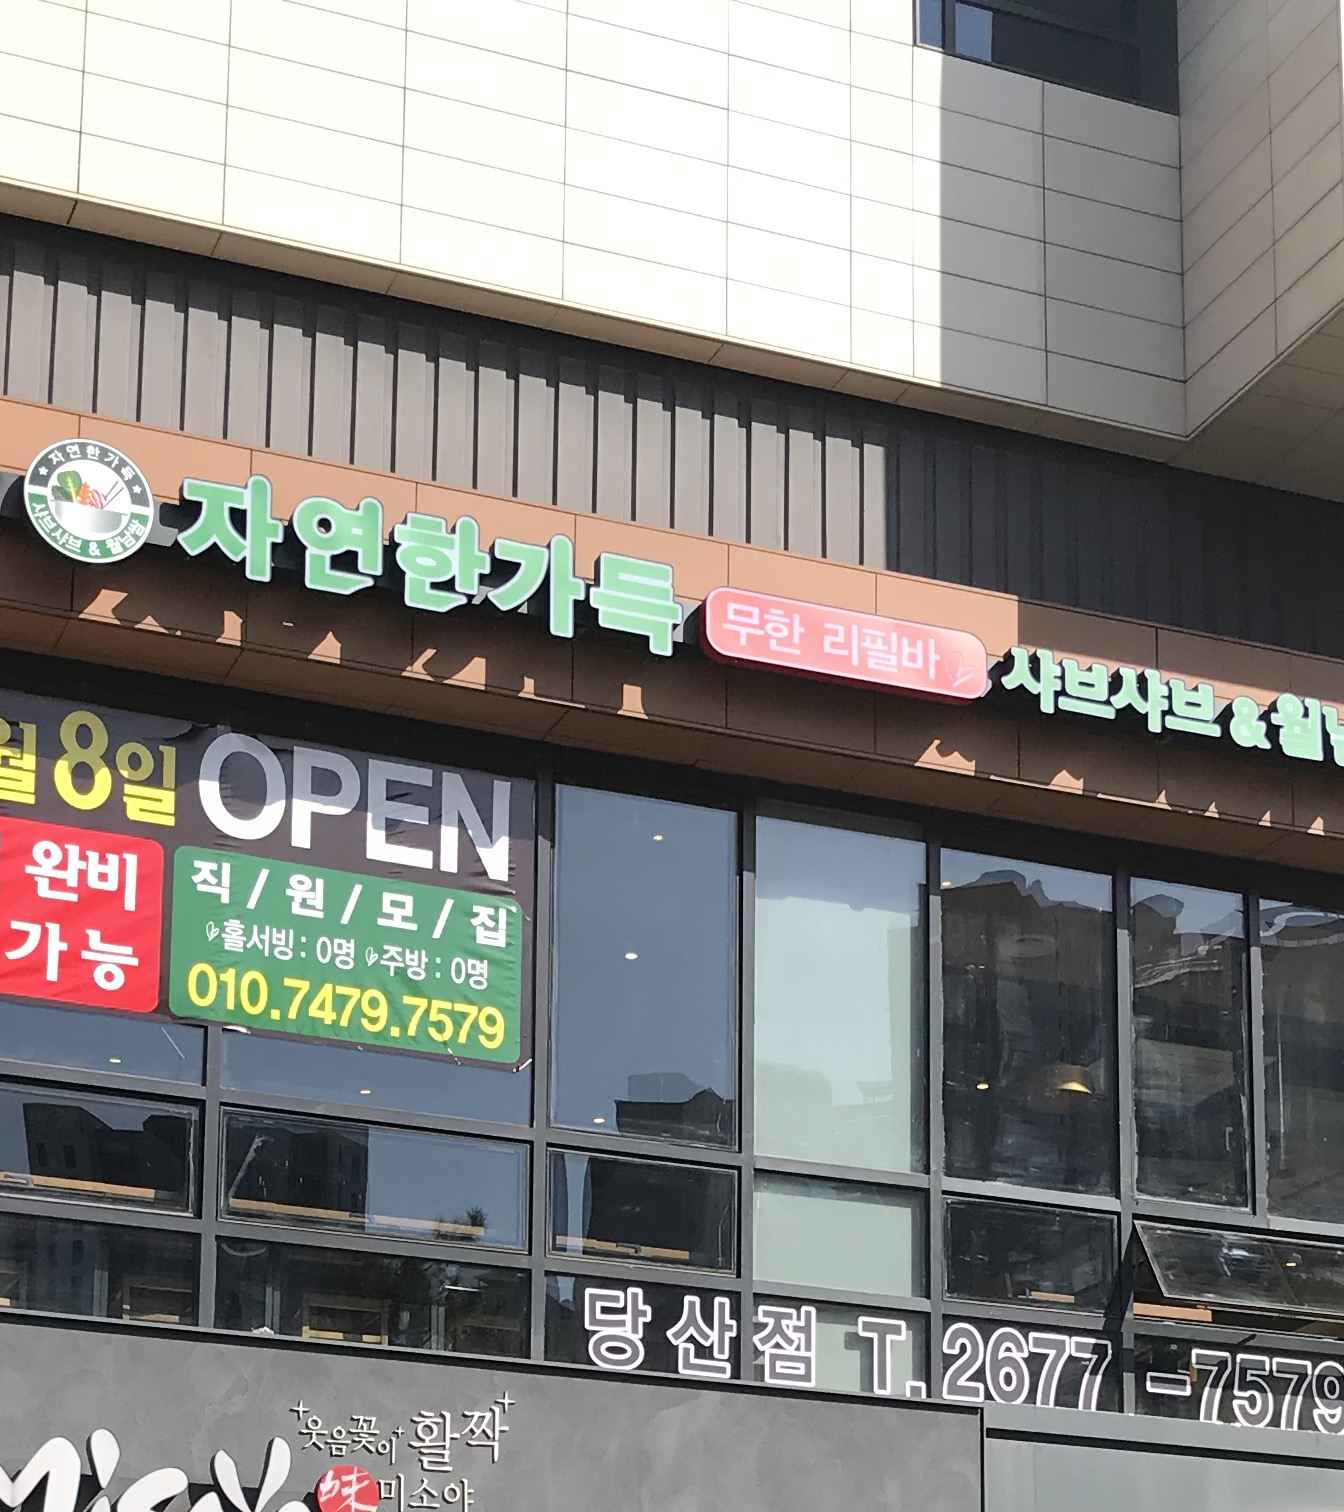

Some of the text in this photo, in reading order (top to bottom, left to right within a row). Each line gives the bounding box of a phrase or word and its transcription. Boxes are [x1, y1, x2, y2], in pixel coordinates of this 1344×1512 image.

[48, 444, 136, 480] 자연한가득
[32, 503, 147, 557] 샤브샤브 & 월남쌈
[177, 474, 683, 657] 자연한가득
[722, 601, 941, 680] 무한 리필바
[54, 710, 176, 827] 8일
[197, 732, 511, 883] OPEN
[25, 840, 137, 911] 완비
[316, 936, 355, 970] 0명
[450, 957, 488, 991] 0명
[187, 963, 505, 1049] 010.7479.7579
[298, 1405, 509, 1473] 웃음꽃이 활짝
